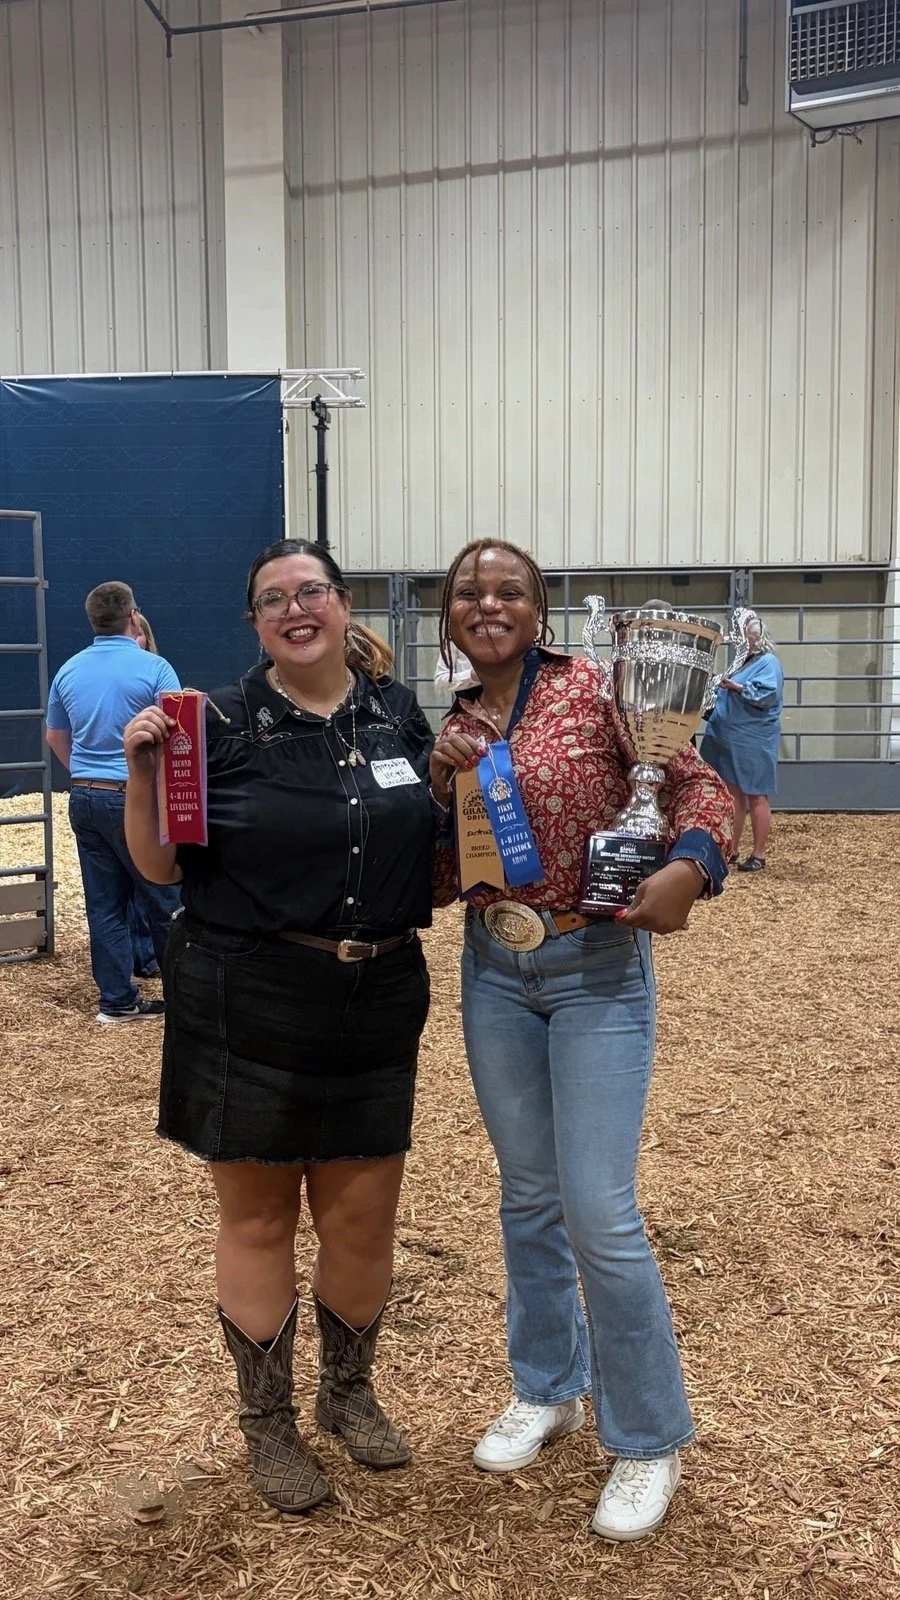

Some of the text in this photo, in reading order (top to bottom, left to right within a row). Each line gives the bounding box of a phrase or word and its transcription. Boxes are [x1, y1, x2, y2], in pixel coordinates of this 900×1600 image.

[172, 760, 191, 768] SECOND
[174, 769, 191, 777] PLACE
[170, 791, 197, 800] 4-H/FFA
[170, 802, 199, 811] LIVESTOCK
[462, 807, 488, 815] GRAN
[497, 802, 513, 813] FIRST
[499, 812, 517, 823] PLACE
[501, 832, 528, 845] 4-H/FFA
[502, 842, 532, 856] LIVESTOCK
[465, 851, 497, 859] CHAMPION
[511, 854, 528, 865] SHOW
